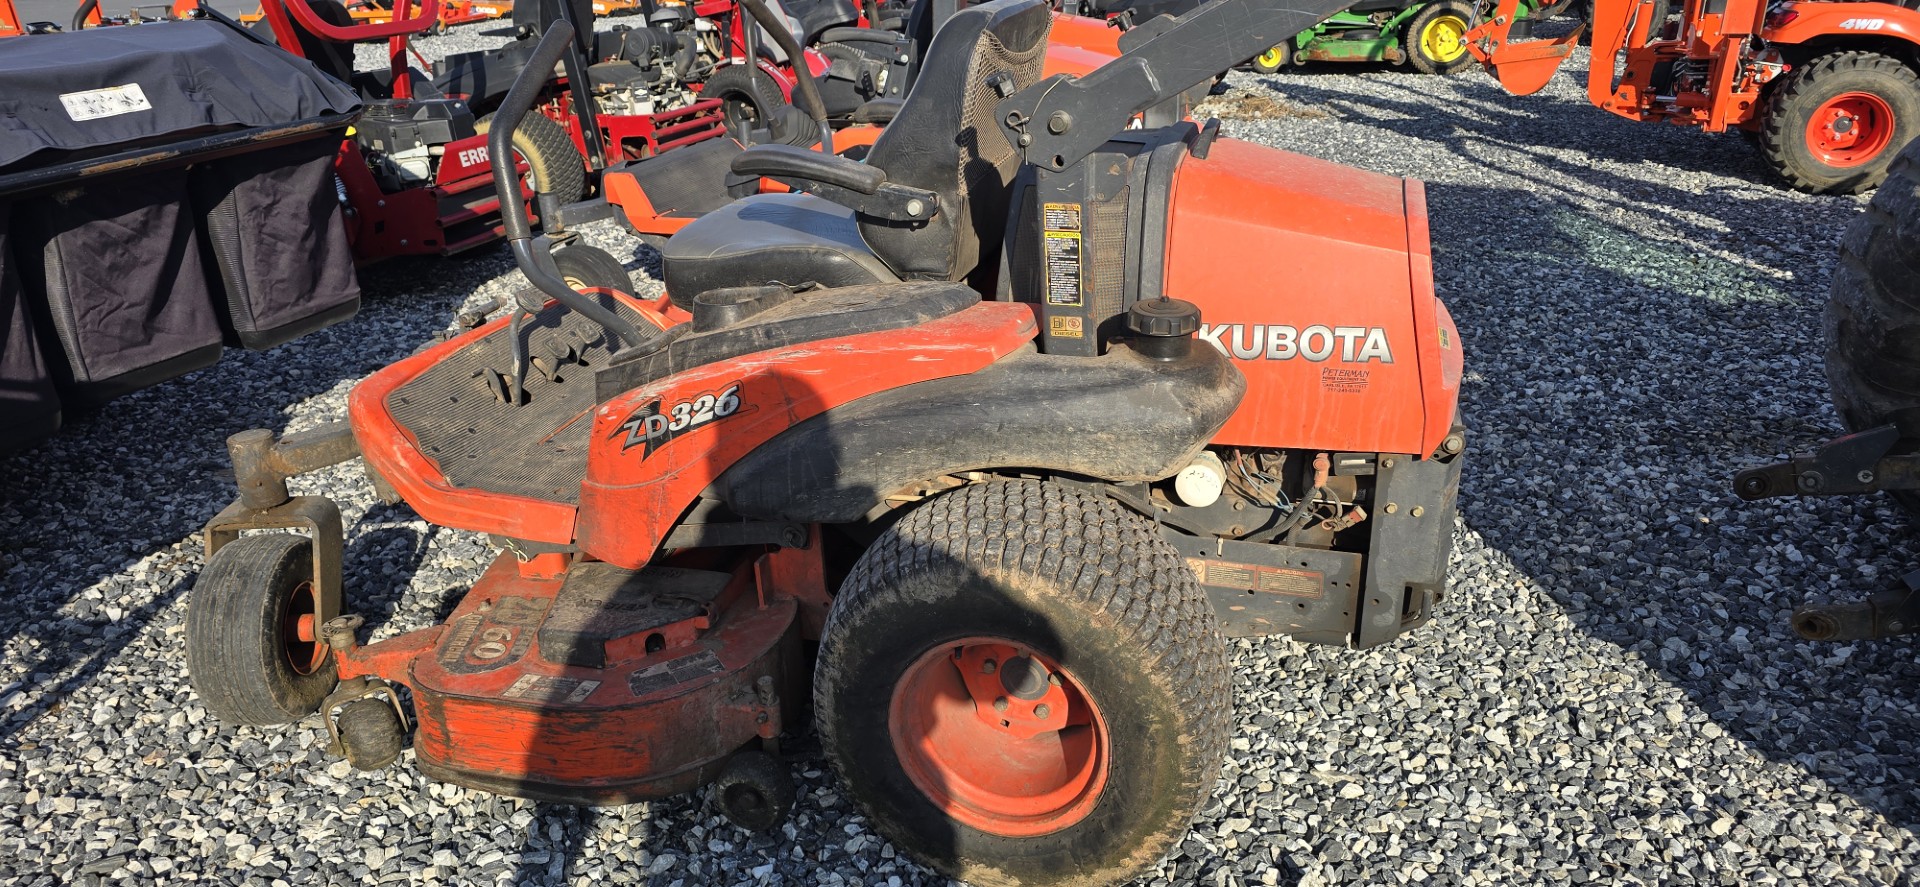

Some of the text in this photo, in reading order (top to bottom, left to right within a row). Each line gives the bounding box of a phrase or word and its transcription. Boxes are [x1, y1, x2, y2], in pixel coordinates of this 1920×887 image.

[1839, 18, 1886, 31] 4WD
[458, 145, 490, 168] ERR
[1198, 323, 1395, 364] KUBOTA
[1322, 367, 1370, 378] PETERMAN
[621, 383, 741, 450] ZD326
[474, 627, 512, 659] 60
